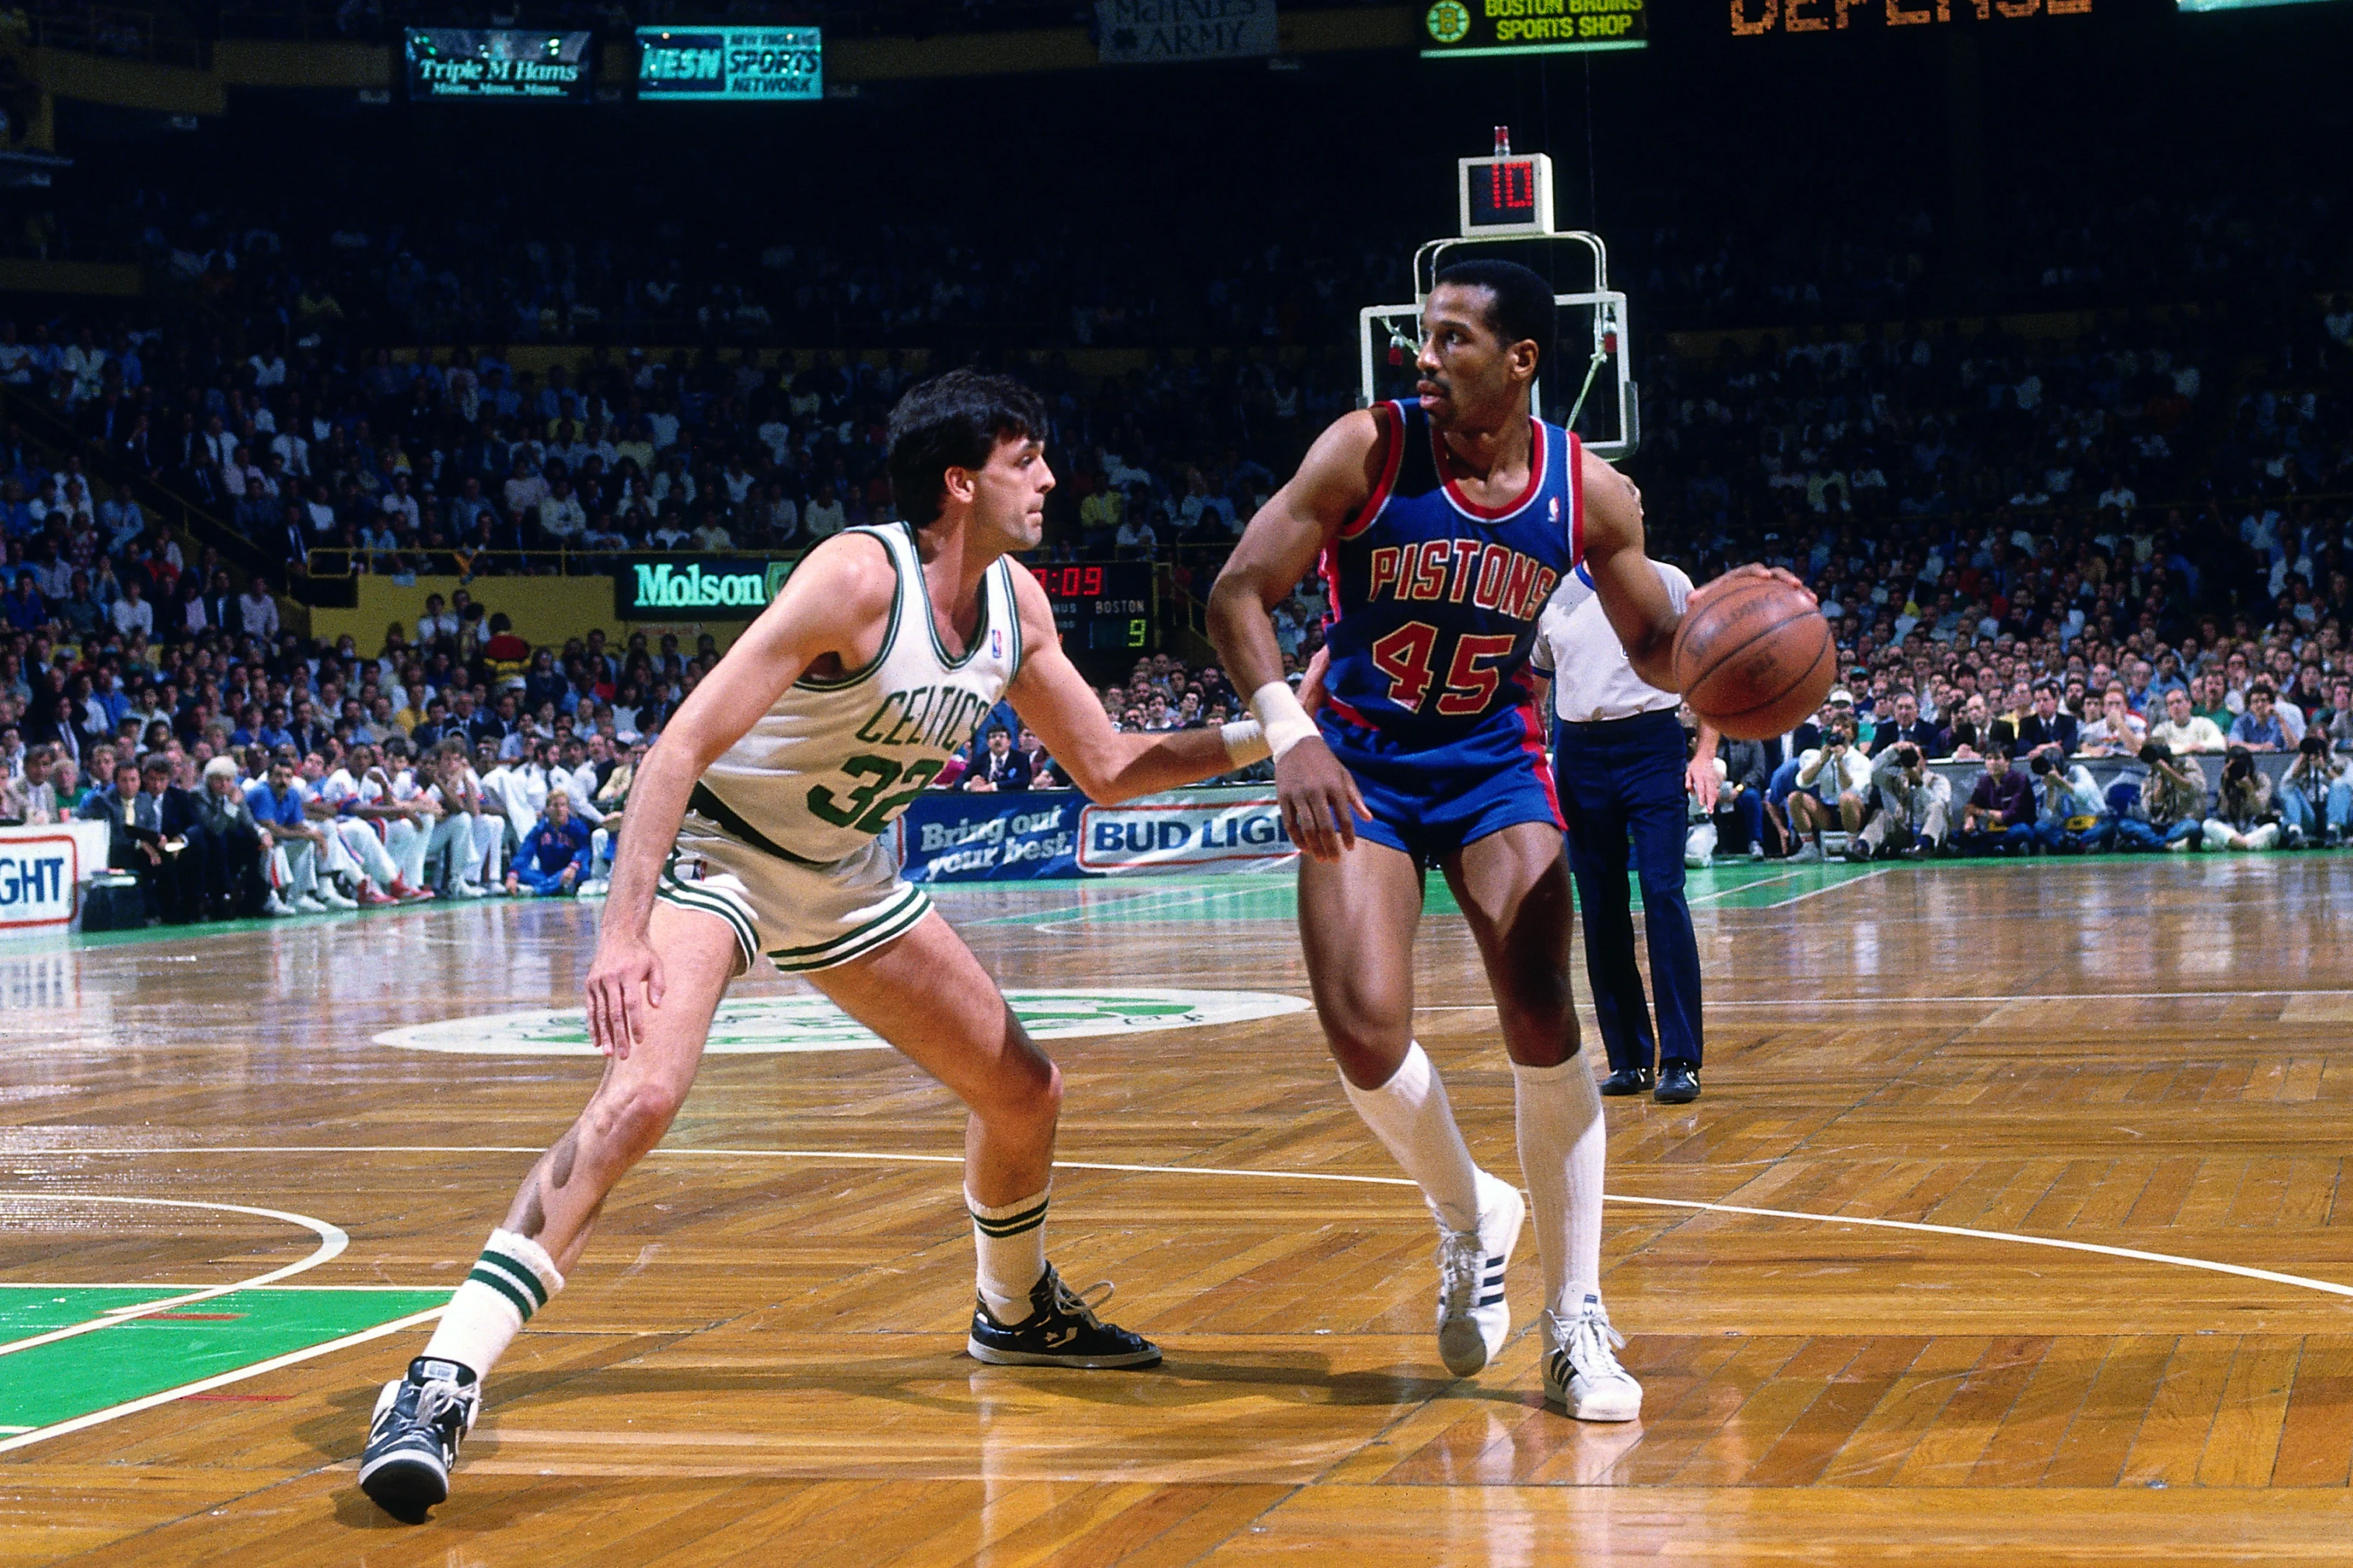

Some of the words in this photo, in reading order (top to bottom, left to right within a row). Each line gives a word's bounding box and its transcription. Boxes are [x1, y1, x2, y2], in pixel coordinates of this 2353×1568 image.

[1485, 0, 1564, 17] BOSTON
[1144, 20, 1246, 54] ARMY
[1496, 17, 1574, 40] SPORTS
[1578, 14, 1633, 37] SHOP
[419, 58, 484, 84] Triple
[486, 60, 513, 80] M
[514, 59, 578, 82] Hams
[638, 48, 722, 80] NESN
[729, 50, 819, 74] SPORTS
[1491, 161, 1533, 209] 10
[632, 562, 767, 607] Molson
[1368, 538, 1557, 622] PISTONS
[1094, 598, 1146, 615] BOSTON
[1127, 618, 1148, 648] 9
[1372, 620, 1516, 716] 45
[807, 754, 945, 834] 32
[920, 817, 1007, 852] Bring
[1093, 821, 1191, 852] BUD
[925, 846, 999, 883] your
